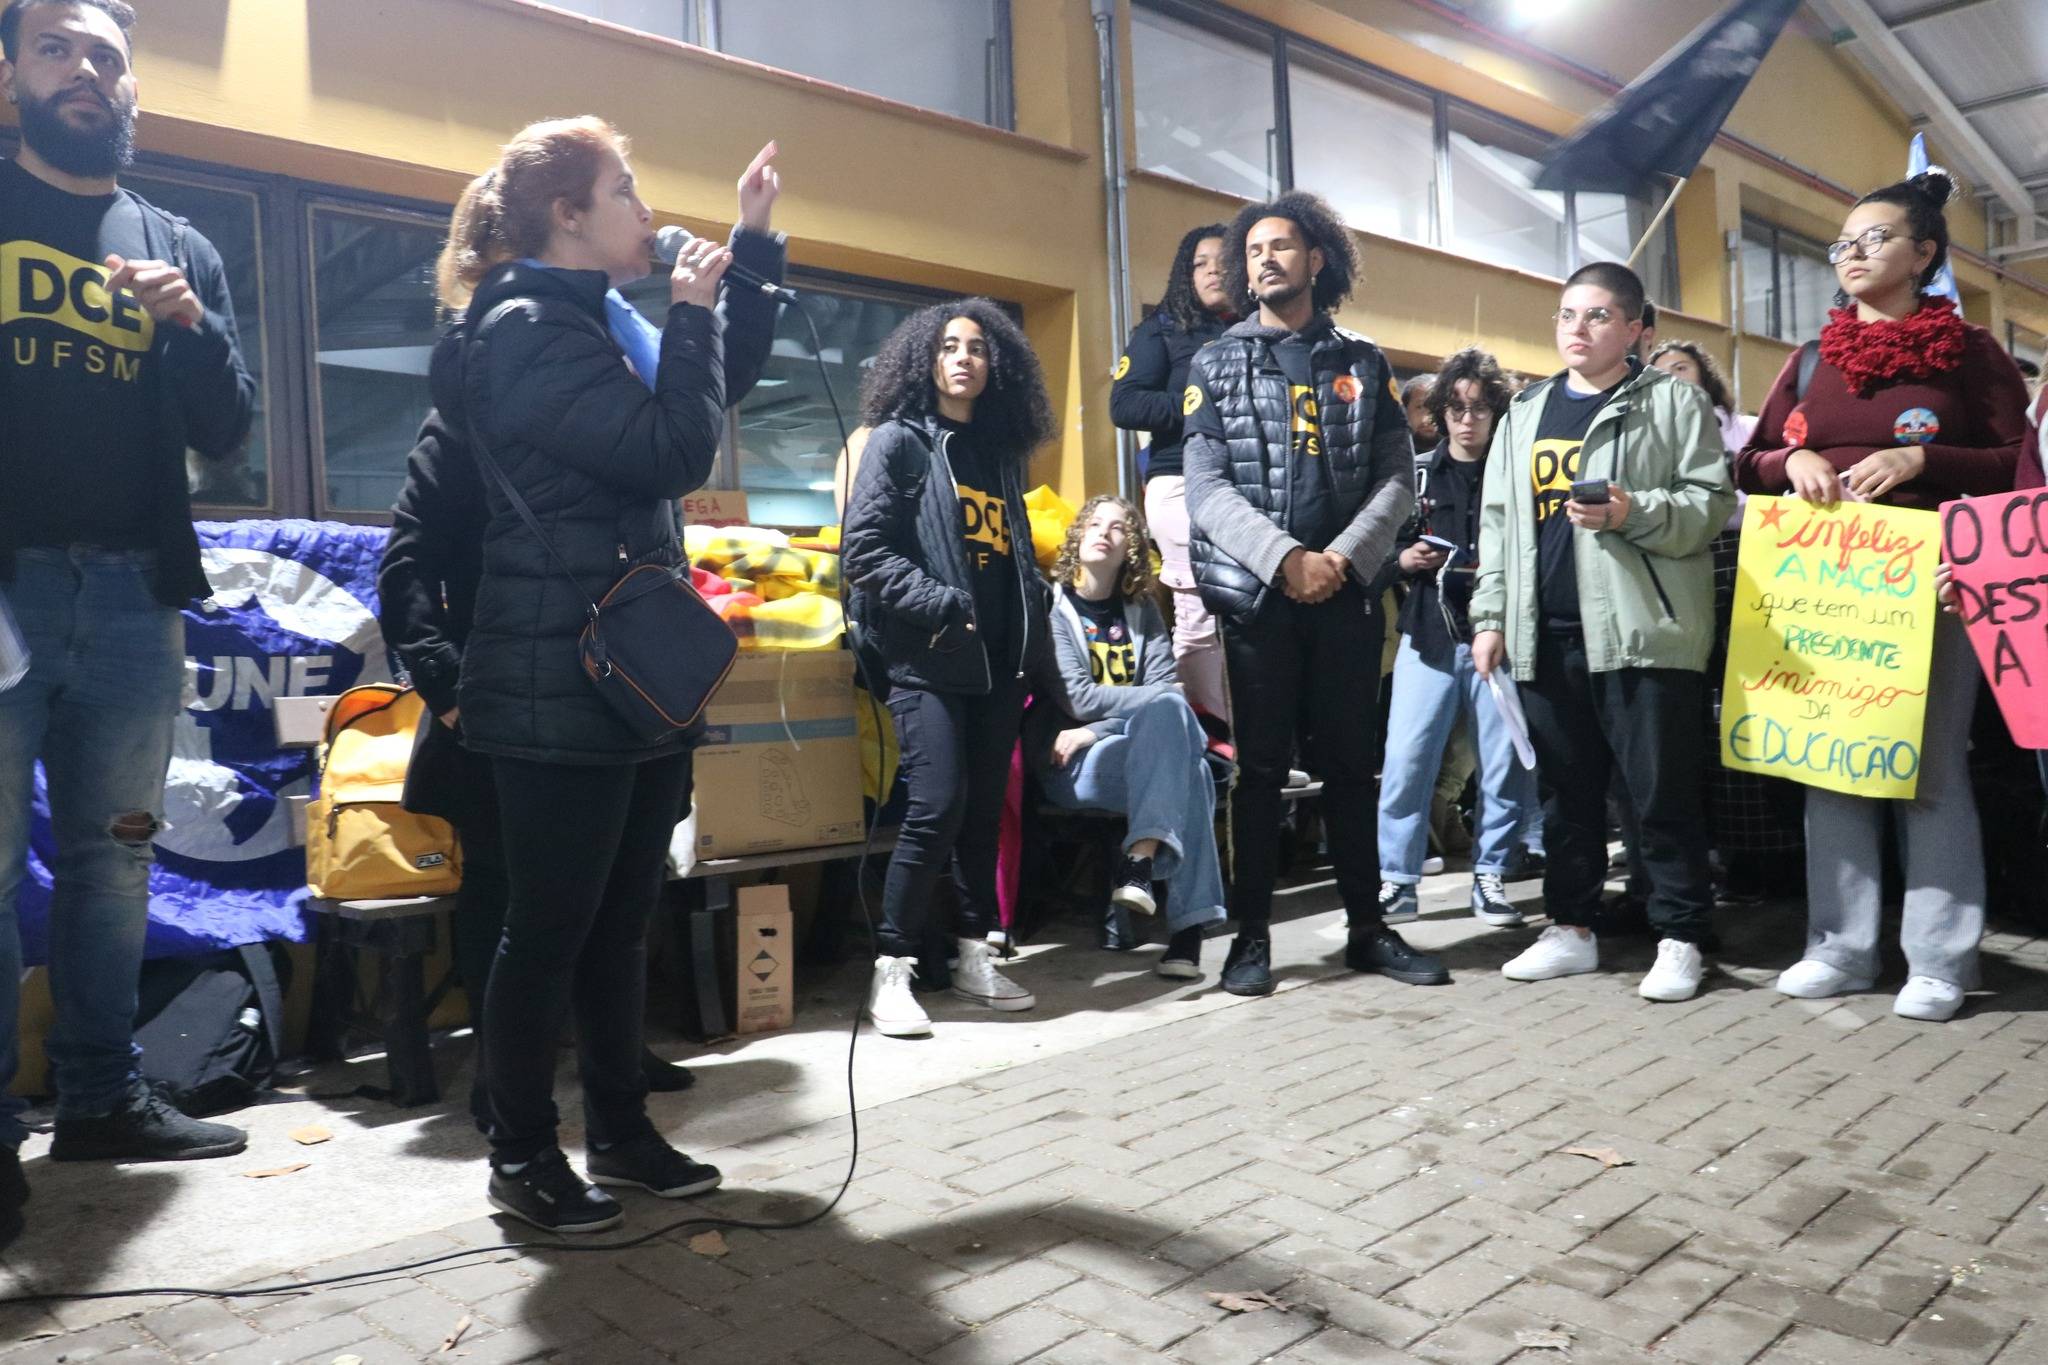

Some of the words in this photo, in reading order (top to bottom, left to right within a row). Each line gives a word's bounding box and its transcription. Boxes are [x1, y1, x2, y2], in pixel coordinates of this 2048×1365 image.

[18, 257, 143, 333] DCE
[14, 336, 141, 383] UFSM
[1776, 510, 1925, 584] infeliz
[1945, 503, 1983, 565] O
[1775, 553, 1807, 583] A
[1819, 559, 1917, 598] NAÇÃO
[1953, 573, 2048, 625] DES
[1751, 592, 1807, 628] que
[1813, 598, 1859, 619] tem
[1864, 608, 1916, 629] um
[183, 655, 333, 711] UNE
[1742, 660, 1926, 718] inimigo
[1799, 700, 1831, 720] DA
[1729, 714, 1920, 784] EDUCAÇÃO
